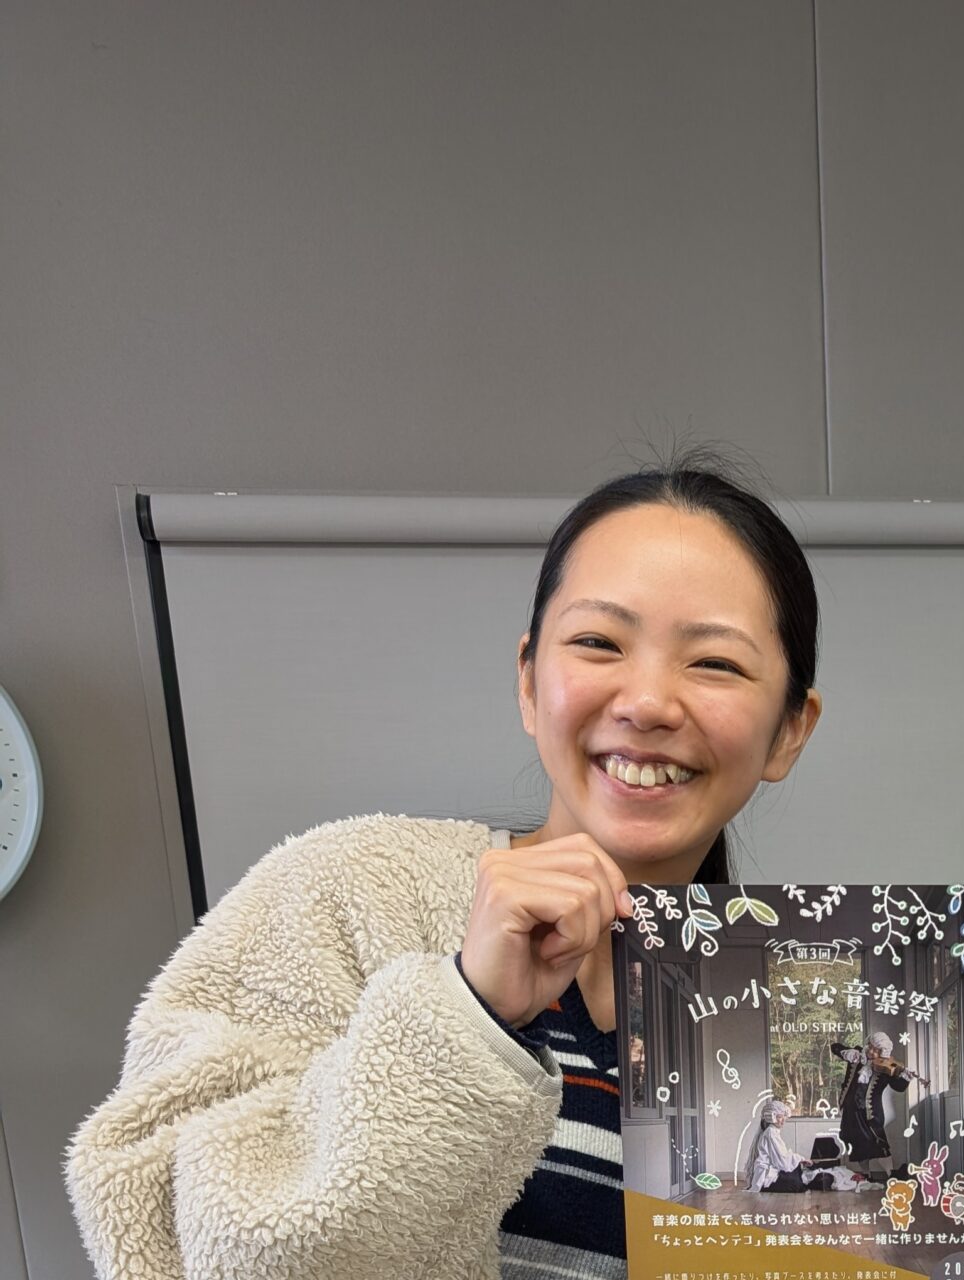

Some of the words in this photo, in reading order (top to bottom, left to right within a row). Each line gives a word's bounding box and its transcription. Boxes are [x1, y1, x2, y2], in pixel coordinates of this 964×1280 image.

[796, 947, 831, 960] 第3回
[687, 976, 939, 1024] 山の小さな音楽祭
[782, 1022, 808, 1033] OLD
[812, 1021, 864, 1033] STREAM
